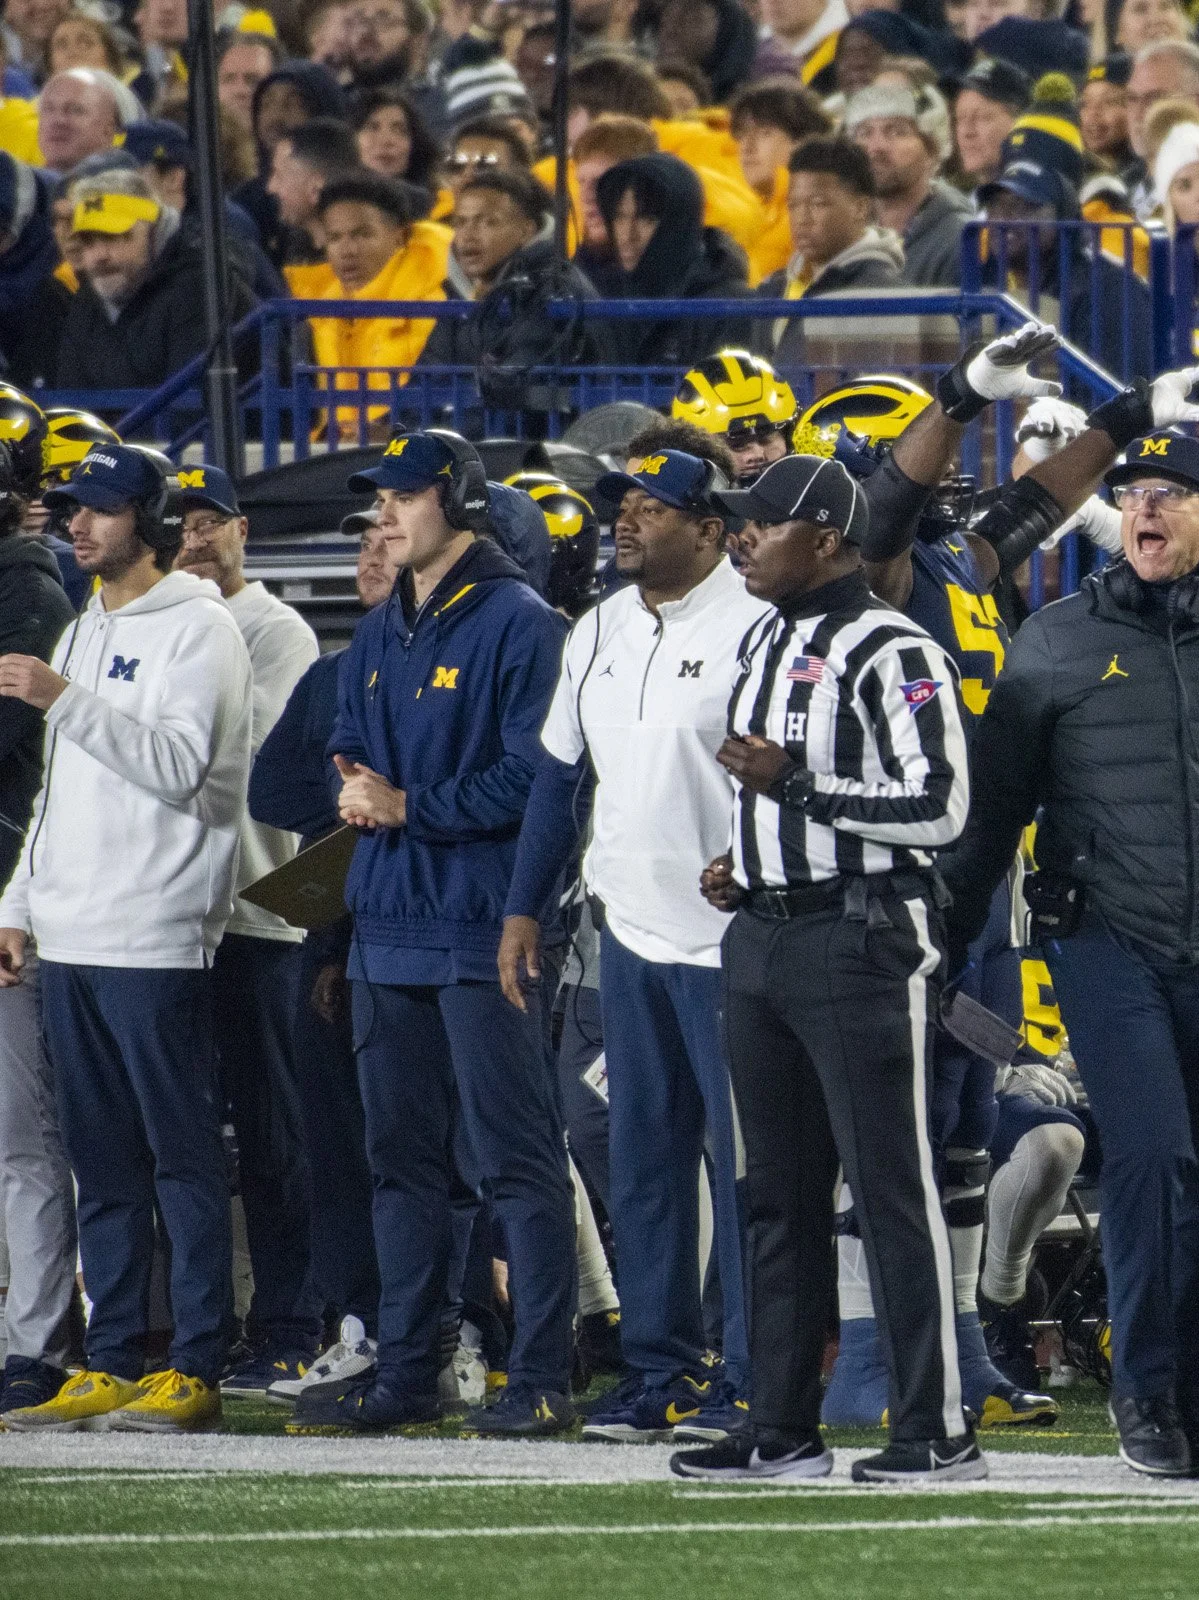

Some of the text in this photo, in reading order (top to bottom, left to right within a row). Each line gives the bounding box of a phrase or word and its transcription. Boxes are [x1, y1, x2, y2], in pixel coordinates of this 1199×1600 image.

[384, 438, 408, 456] M
[1139, 438, 1171, 456] M
[637, 456, 668, 475] M
[177, 469, 206, 489] M
[465, 499, 486, 512] meijer
[816, 509, 829, 522] S
[107, 654, 141, 682] M
[432, 666, 460, 689] M
[678, 659, 704, 679] M
[785, 712, 807, 741] H
